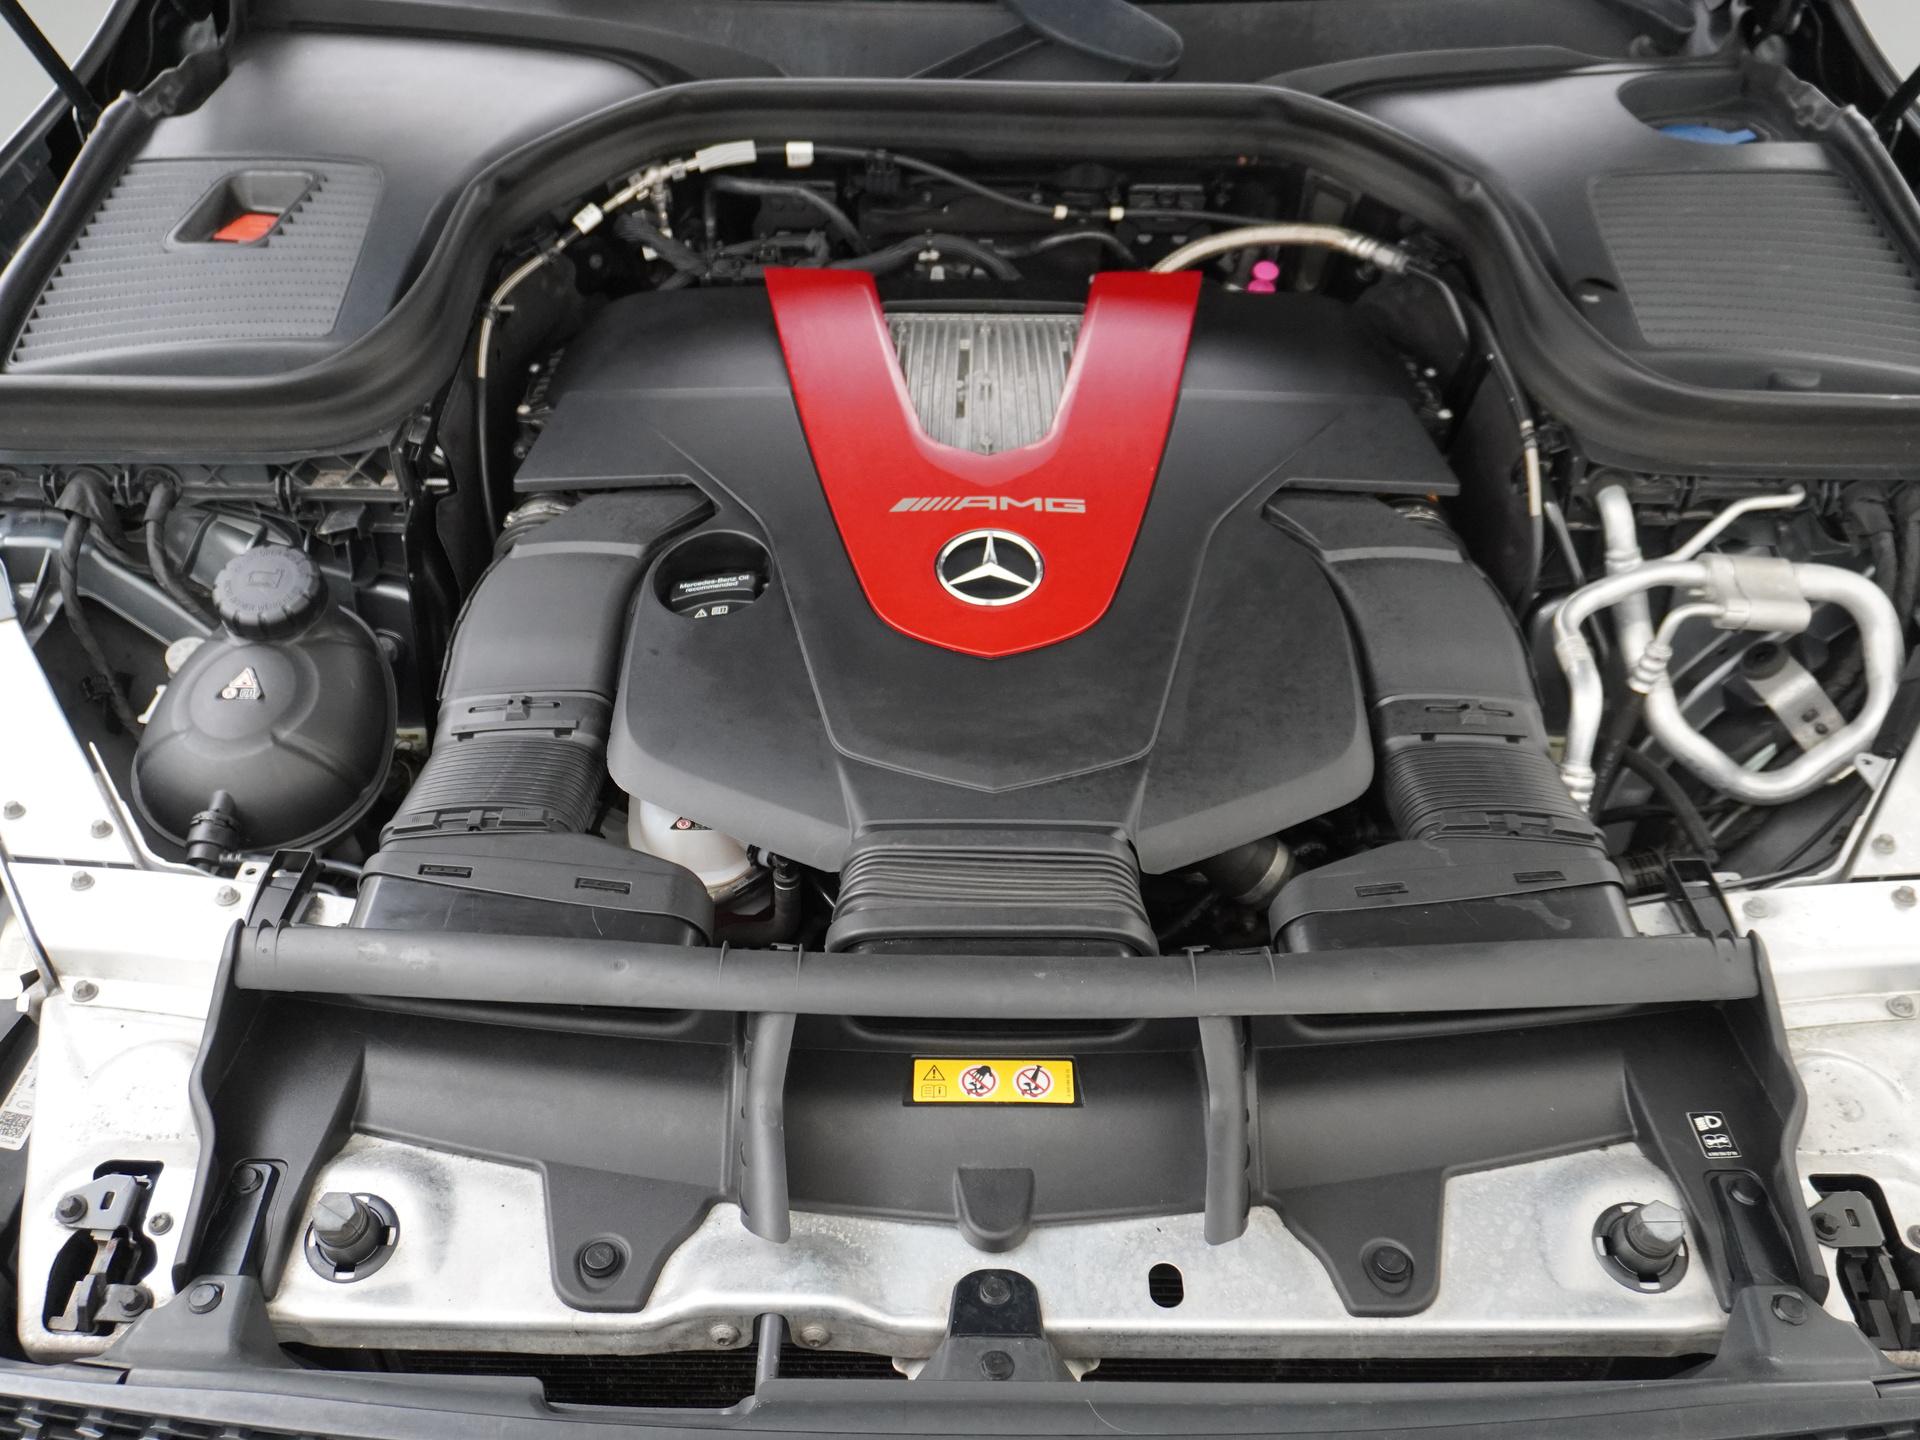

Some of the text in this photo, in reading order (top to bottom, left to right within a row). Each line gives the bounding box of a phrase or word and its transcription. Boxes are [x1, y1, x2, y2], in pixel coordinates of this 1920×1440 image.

[953, 496, 1086, 513] AMG
[680, 576, 737, 589] Mercedes-Benz
[685, 581, 739, 592] recommended
